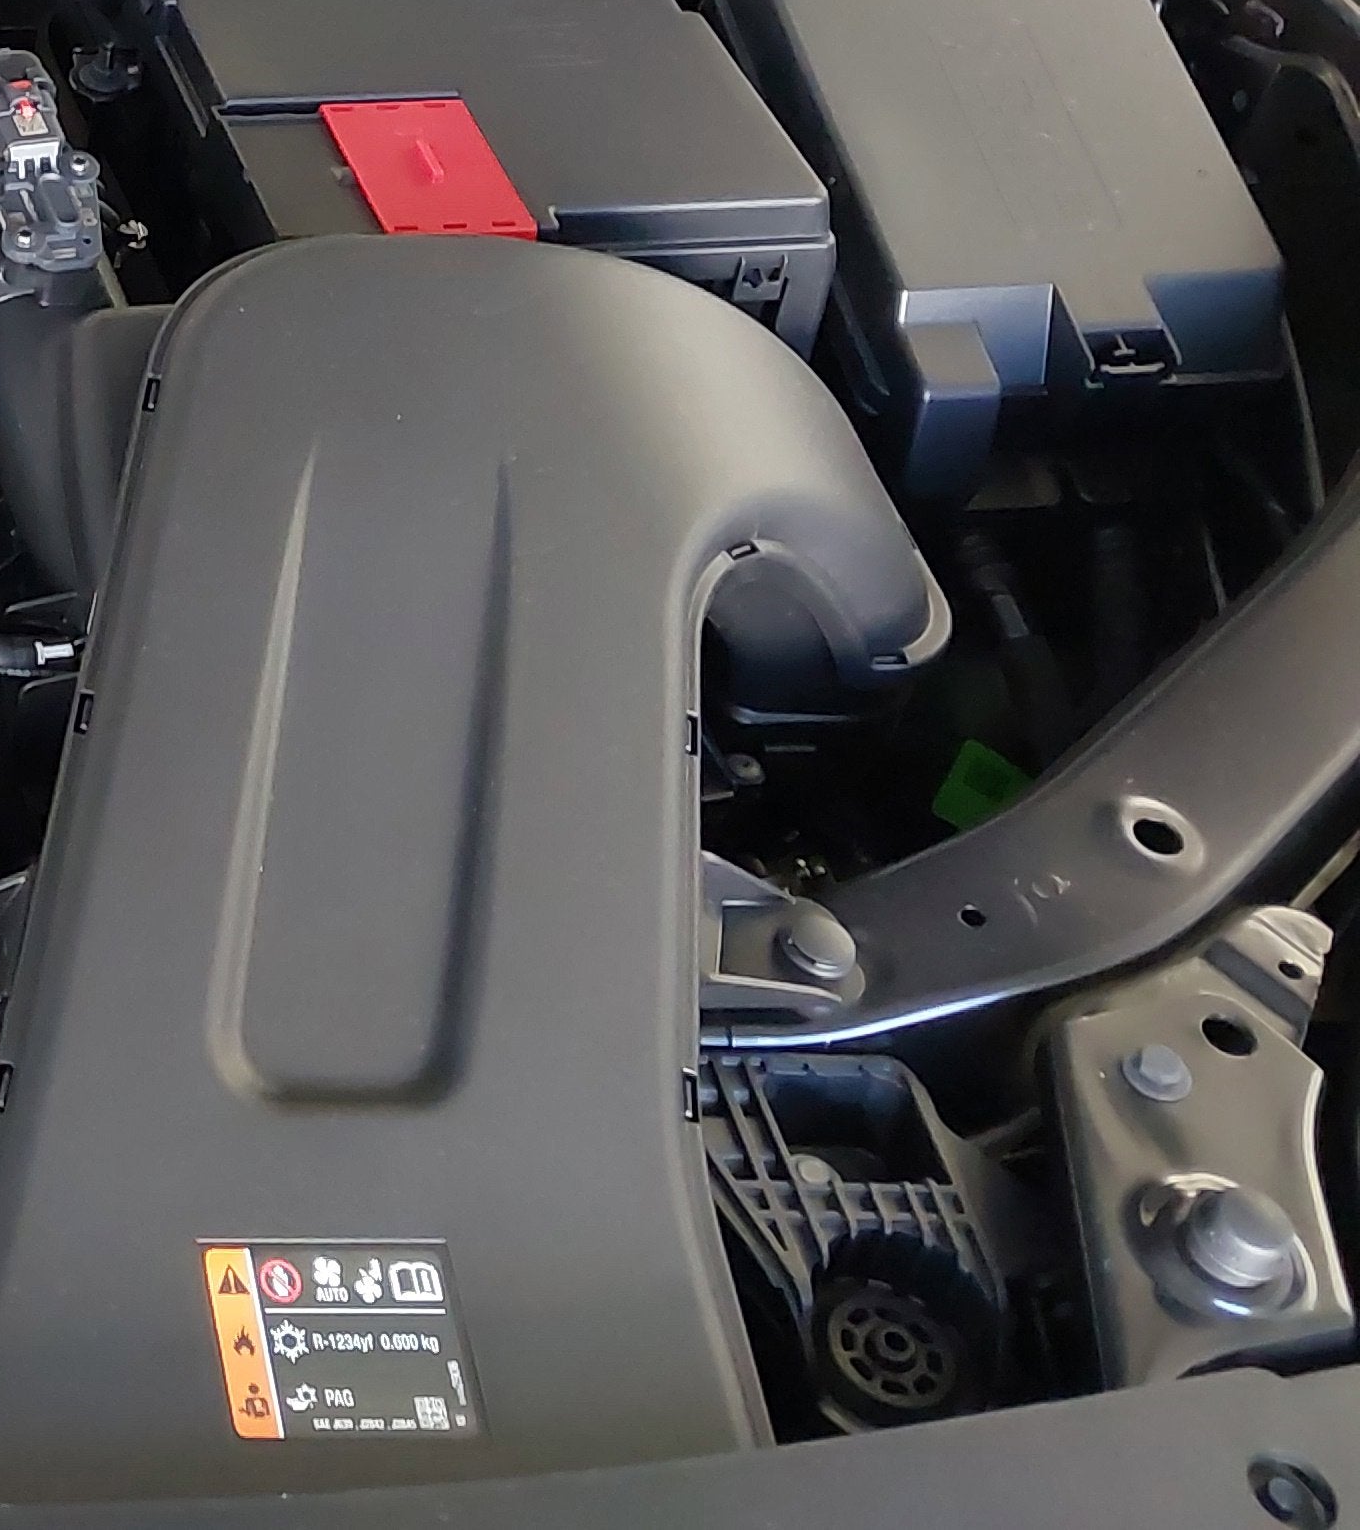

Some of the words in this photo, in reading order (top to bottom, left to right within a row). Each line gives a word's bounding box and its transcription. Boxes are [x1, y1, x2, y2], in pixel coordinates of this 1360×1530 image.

[315, 1287, 349, 1303] AUTO
[312, 1333, 374, 1355] R-1234yf
[420, 1333, 441, 1355] kg
[325, 1389, 356, 1408] PAG
